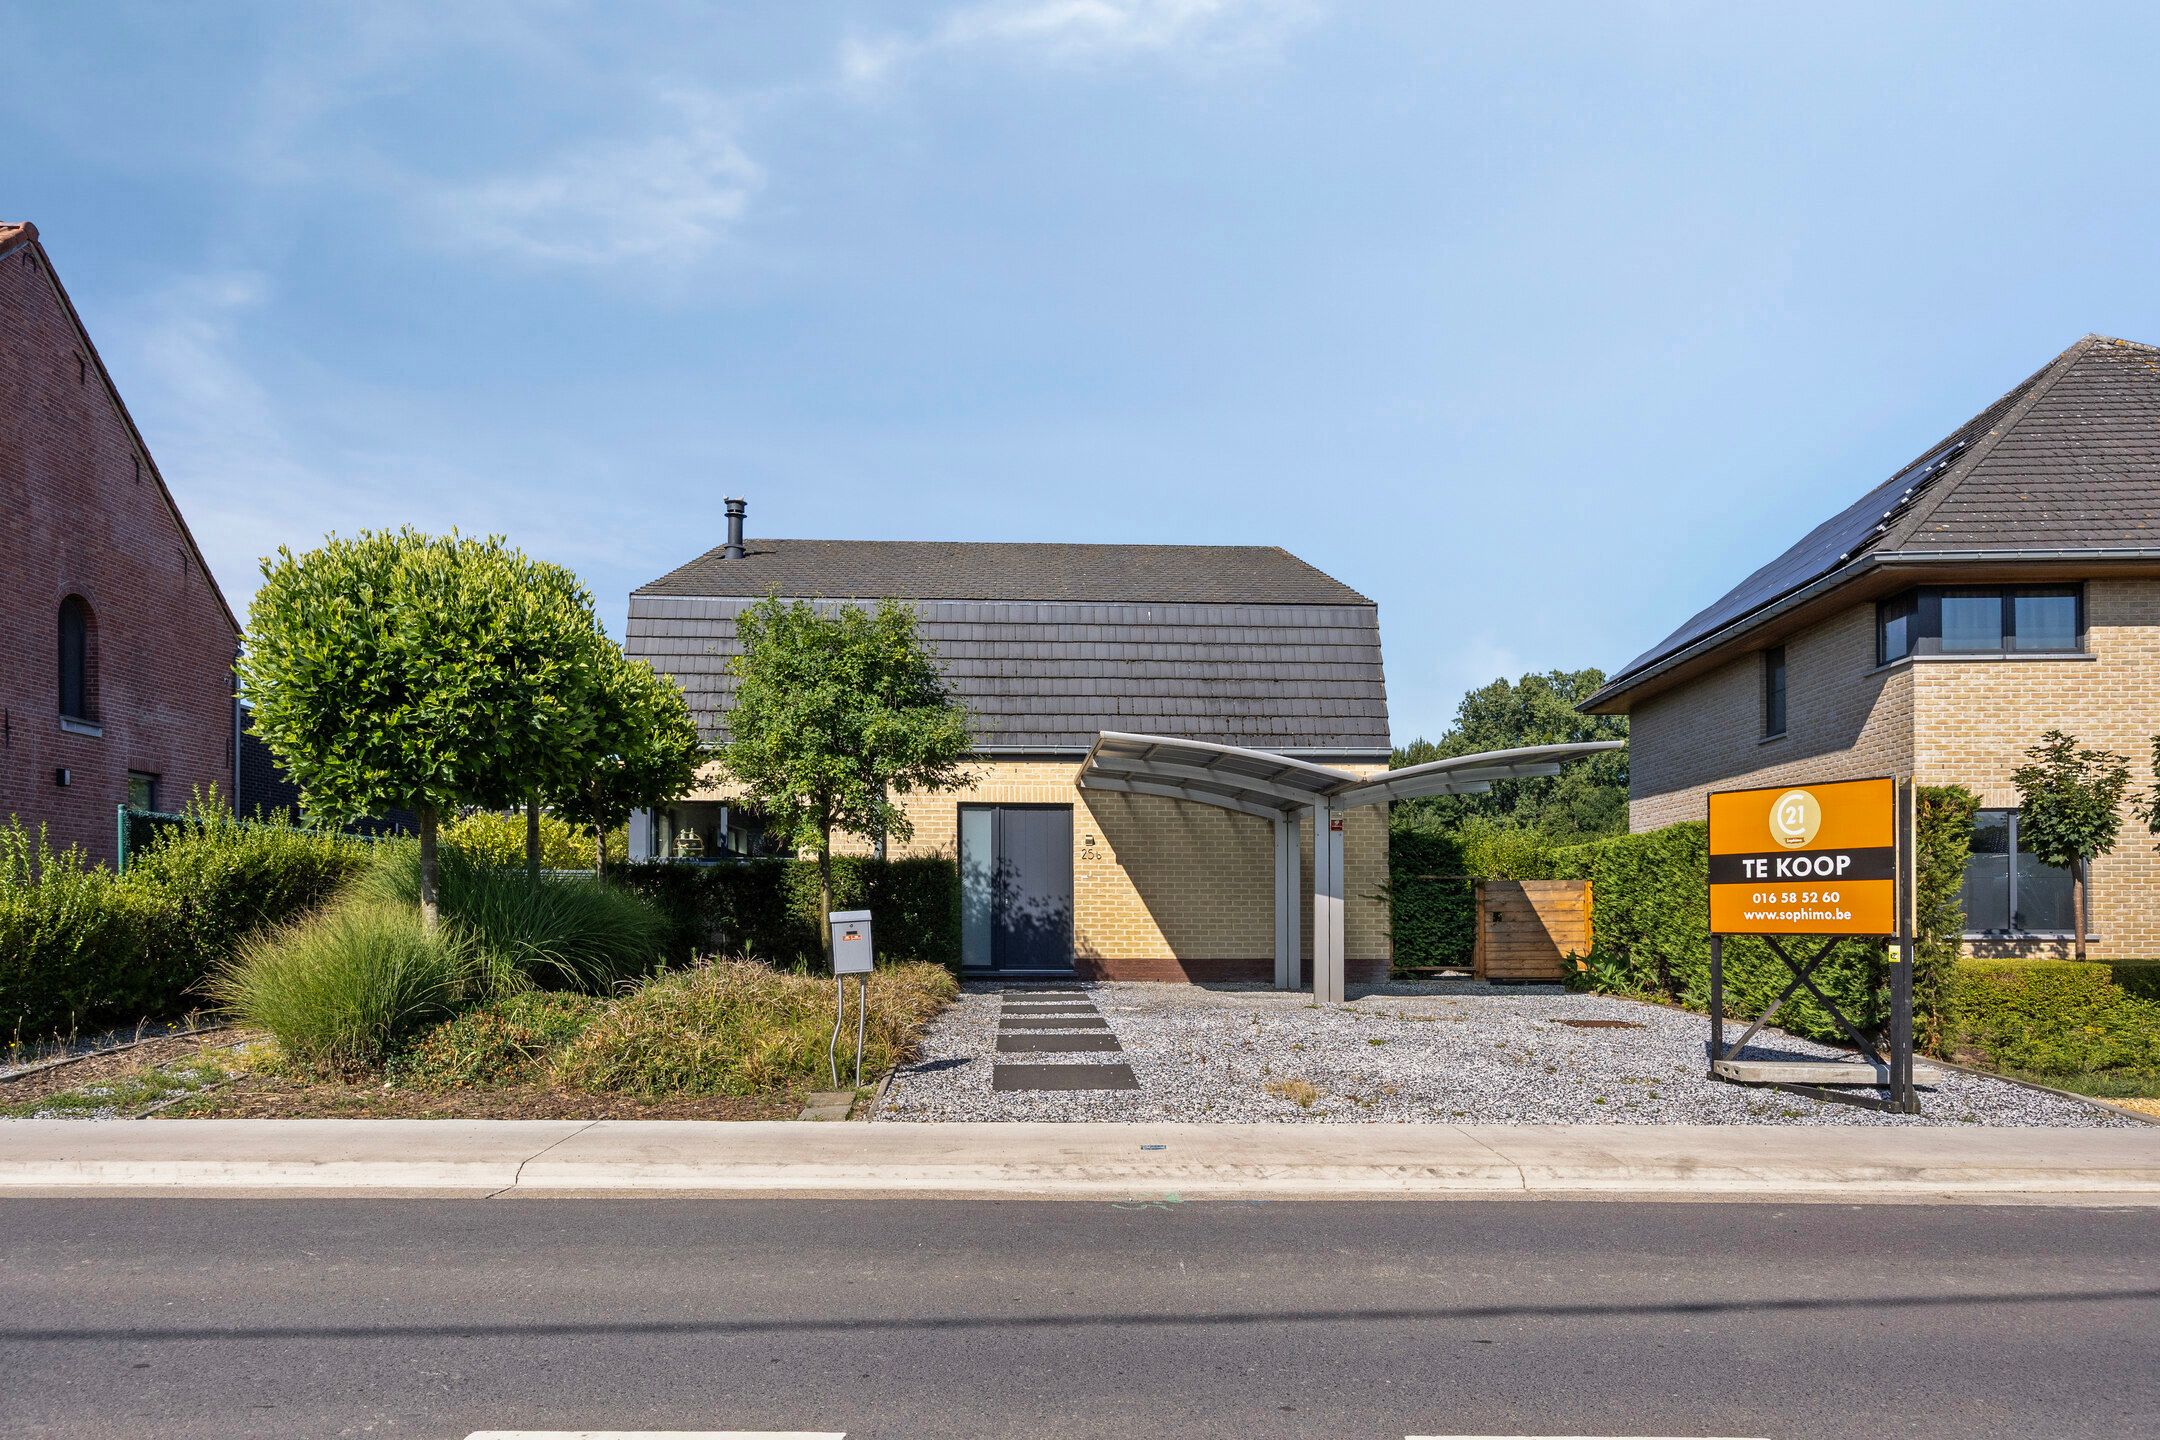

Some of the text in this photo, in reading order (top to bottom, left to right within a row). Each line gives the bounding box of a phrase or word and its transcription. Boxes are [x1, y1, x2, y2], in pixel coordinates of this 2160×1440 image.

[1742, 855, 1851, 878] TE KOOP
[1752, 891, 1840, 904] 016 58 52 60
[1743, 907, 1852, 923] www.sophimo.be
